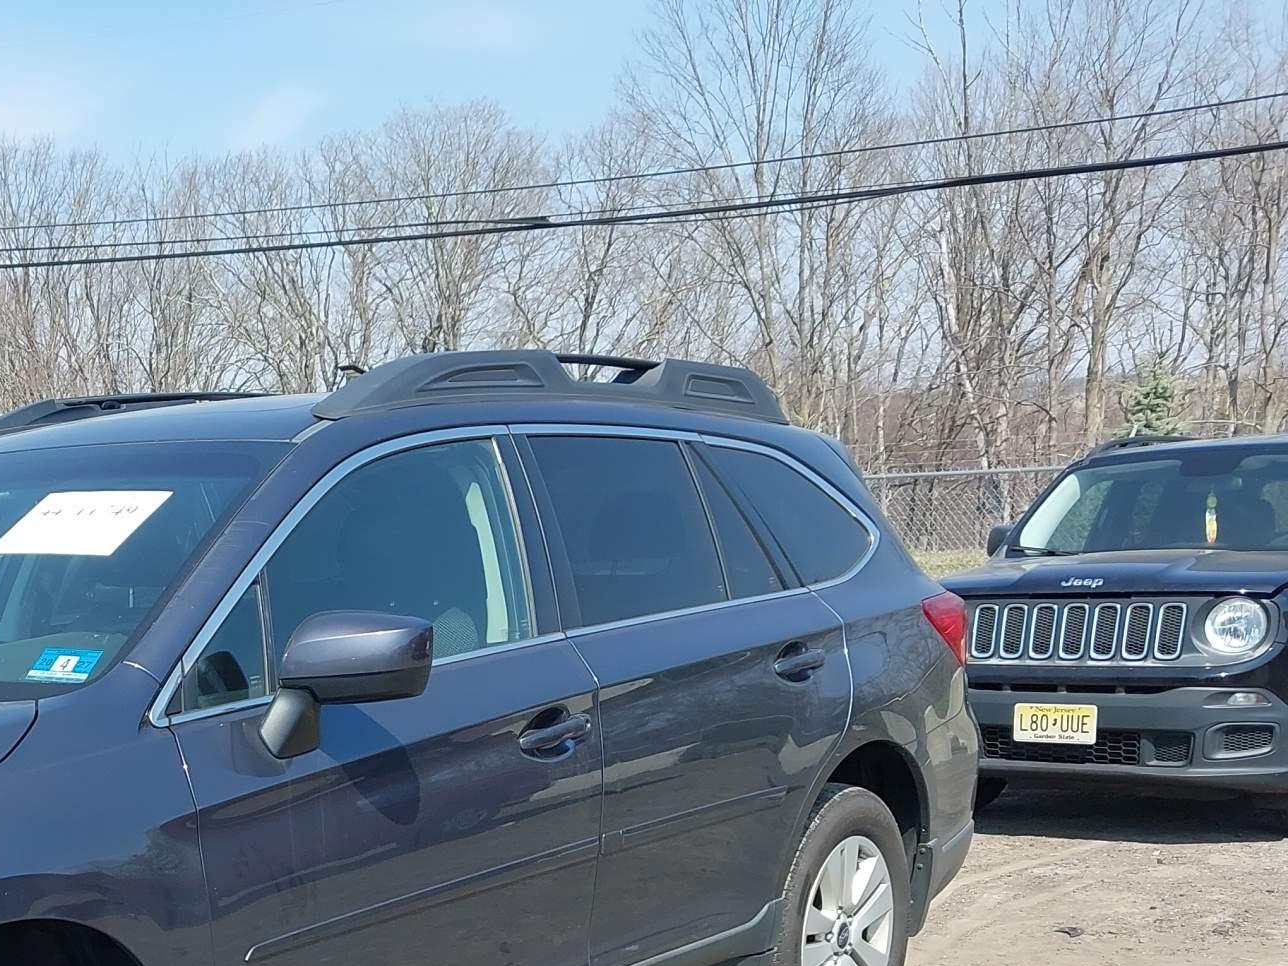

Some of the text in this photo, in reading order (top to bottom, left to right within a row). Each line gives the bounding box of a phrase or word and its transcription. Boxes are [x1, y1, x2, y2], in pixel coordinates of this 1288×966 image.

[1061, 577, 1104, 589] Jeep
[60, 658, 72, 671] 4
[1053, 706, 1078, 714] Jersey
[1019, 713, 1091, 734] L80 UUE
